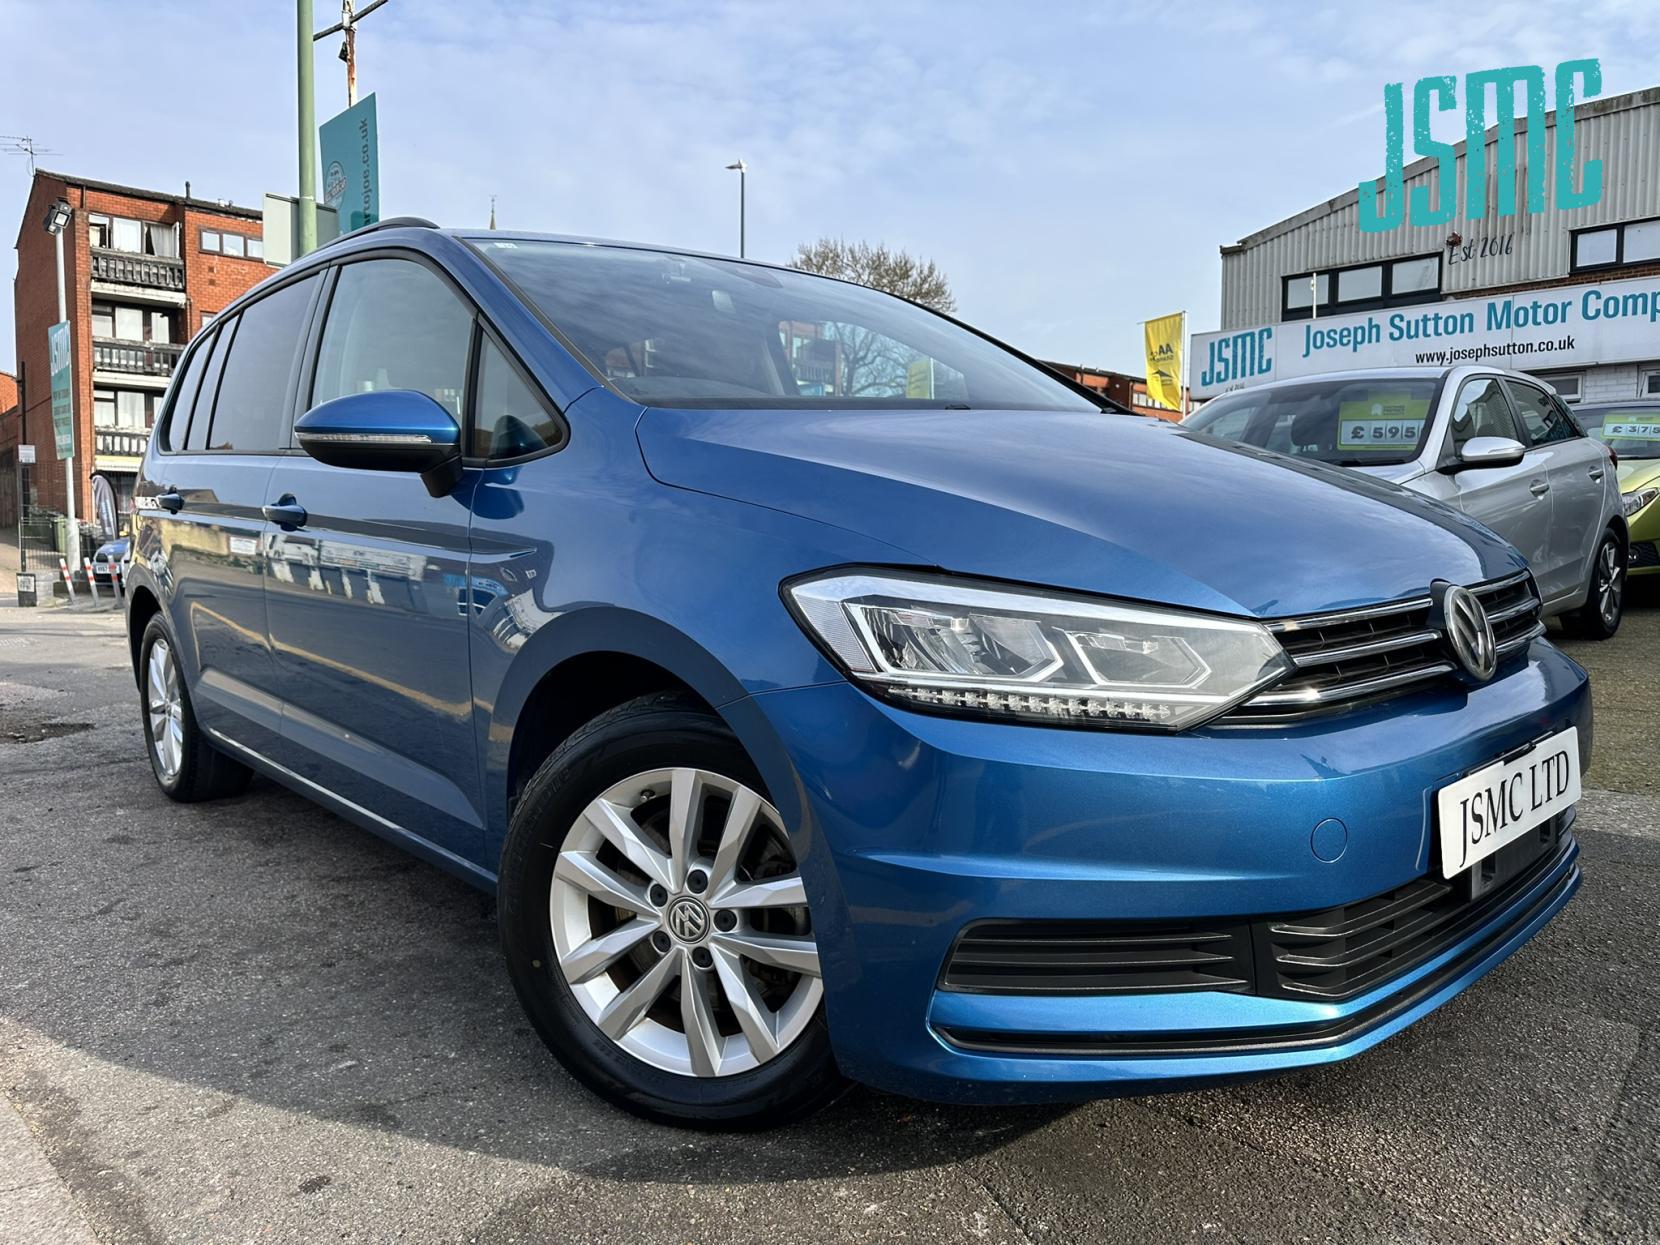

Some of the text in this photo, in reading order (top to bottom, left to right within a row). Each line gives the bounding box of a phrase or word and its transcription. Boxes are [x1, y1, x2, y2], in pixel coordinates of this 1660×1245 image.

[1480, 234, 1513, 258] 2016
[1302, 290, 1660, 358] Joseph Sutton Motor Comp
[1415, 335, 1575, 366] www.josephsutton.co.uk
[1201, 327, 1273, 387] JSMC
[1459, 750, 1570, 868] JSMC LTD
